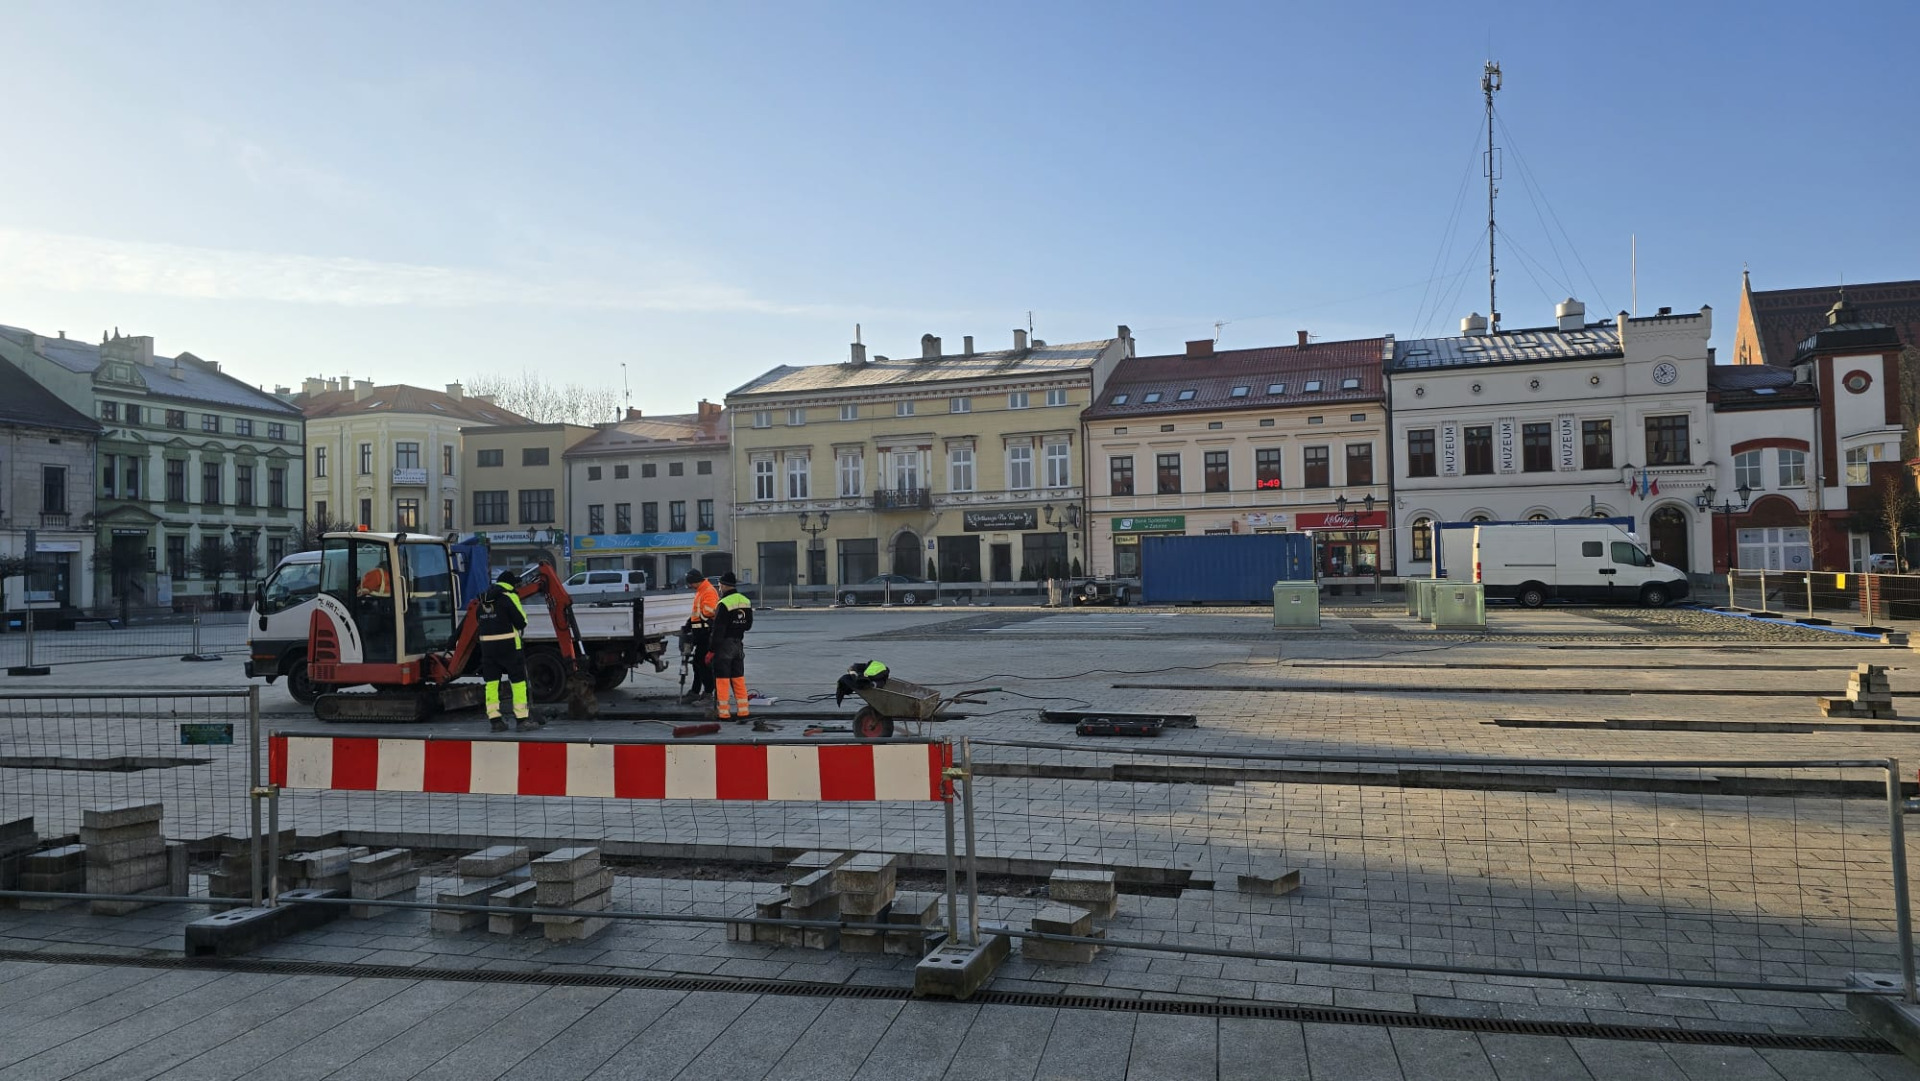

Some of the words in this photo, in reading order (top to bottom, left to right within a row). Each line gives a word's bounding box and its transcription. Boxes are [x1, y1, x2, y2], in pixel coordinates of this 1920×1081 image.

[1444, 427, 1455, 472] MUZEUM
[1502, 423, 1513, 469] MUZEUM
[1562, 419, 1573, 466] MUZEUM
[600, 535, 640, 547] Salon
